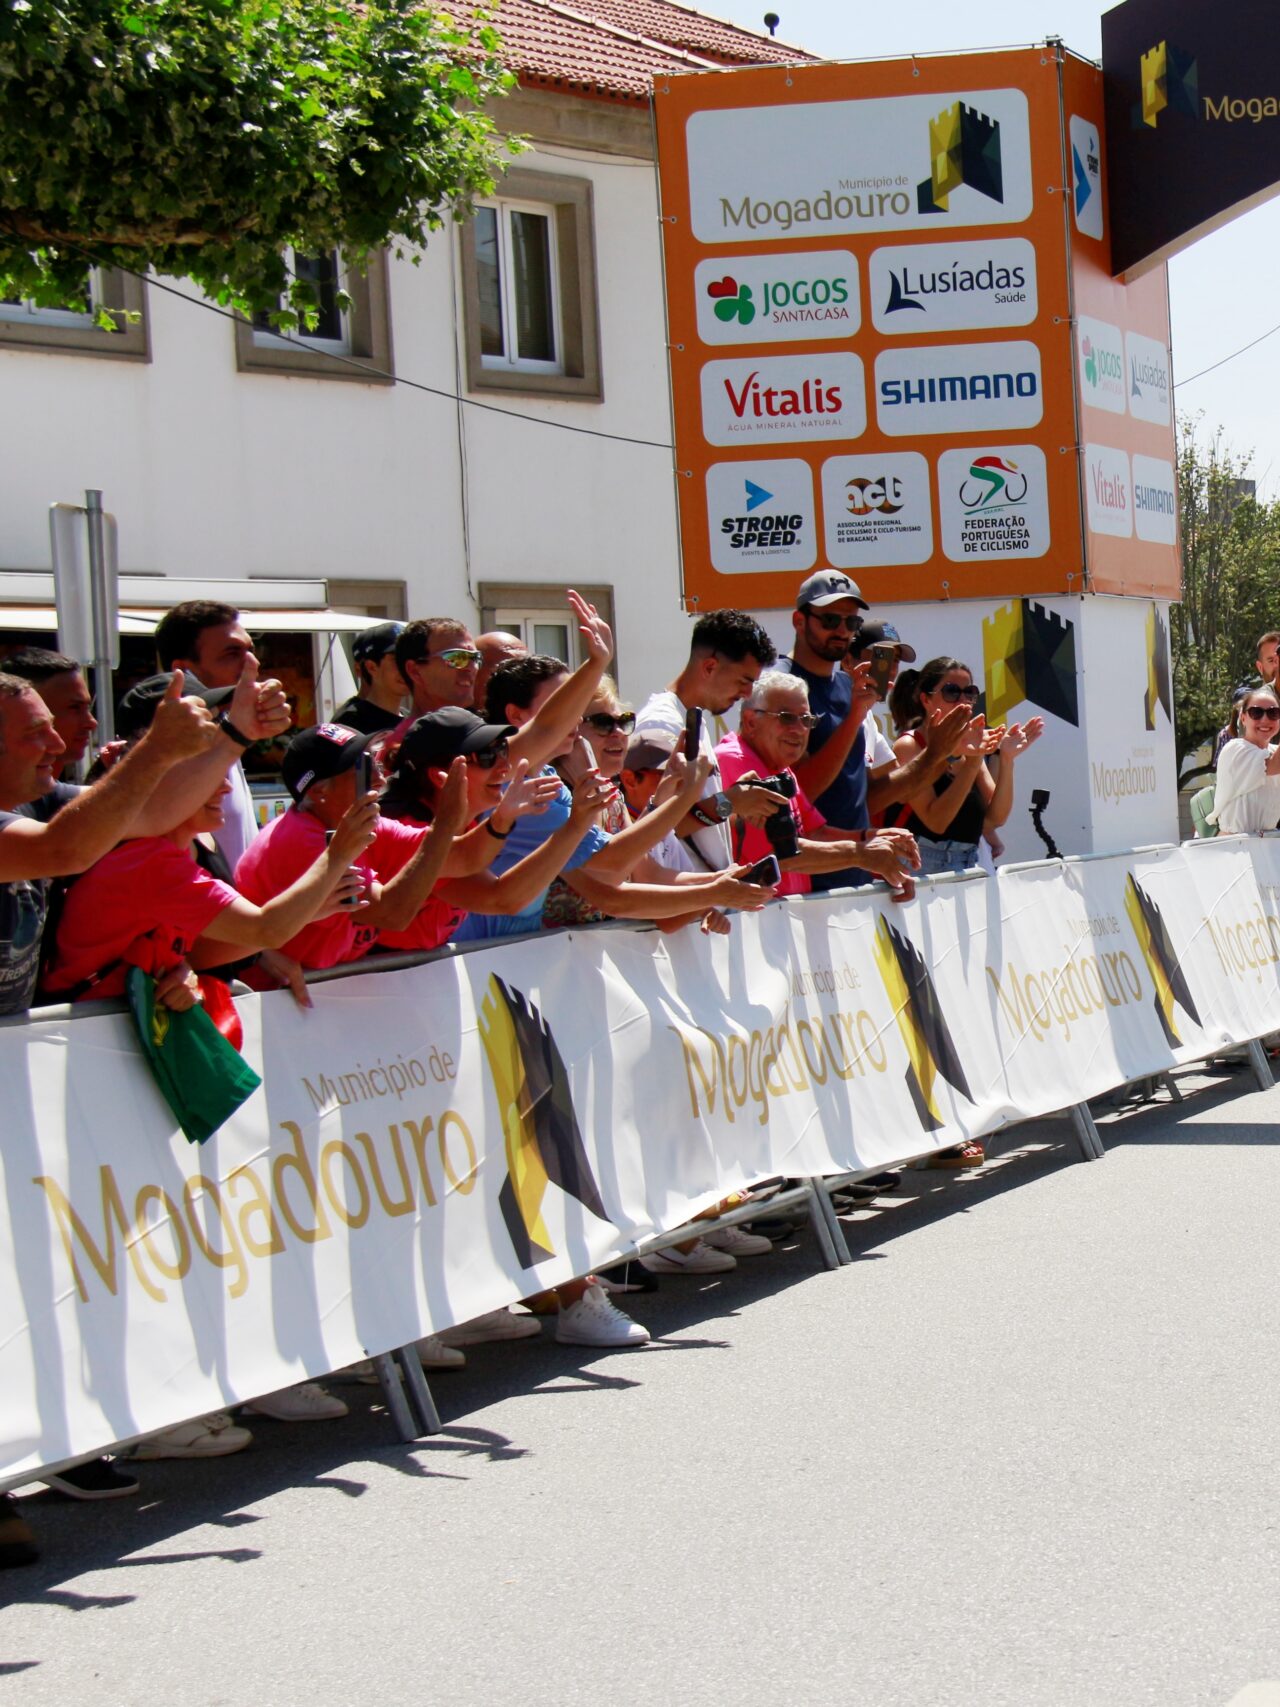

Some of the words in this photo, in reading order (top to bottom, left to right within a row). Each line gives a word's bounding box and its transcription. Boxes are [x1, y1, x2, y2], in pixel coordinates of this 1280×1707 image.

[895, 174, 909, 186] de
[720, 190, 910, 231] Mogadouro
[903, 260, 1026, 295] Lusíadas
[763, 277, 849, 316] JOGOS
[994, 292, 1026, 304] Saúde
[724, 371, 843, 418] Vitalis
[881, 372, 1037, 406] SHIMANO
[756, 420, 797, 430] MINERAL
[801, 418, 842, 428] NATURAL
[1092, 460, 1126, 511] Vitalis
[1135, 485, 1175, 516] SHIMANO
[721, 514, 803, 534] STRONG
[961, 529, 1031, 542] PORTUGUESA
[964, 515, 1026, 530] FEDERAÇÃO
[964, 543, 978, 553] DE
[980, 540, 1030, 552] CICLISMO
[1092, 758, 1157, 806] Mogadouro
[986, 944, 1142, 1043] Mogadouro
[302, 1053, 427, 1113] Município
[429, 1045, 458, 1083] de
[667, 1001, 888, 1126] Mogadouro
[32, 1110, 479, 1303] Mogadouro
